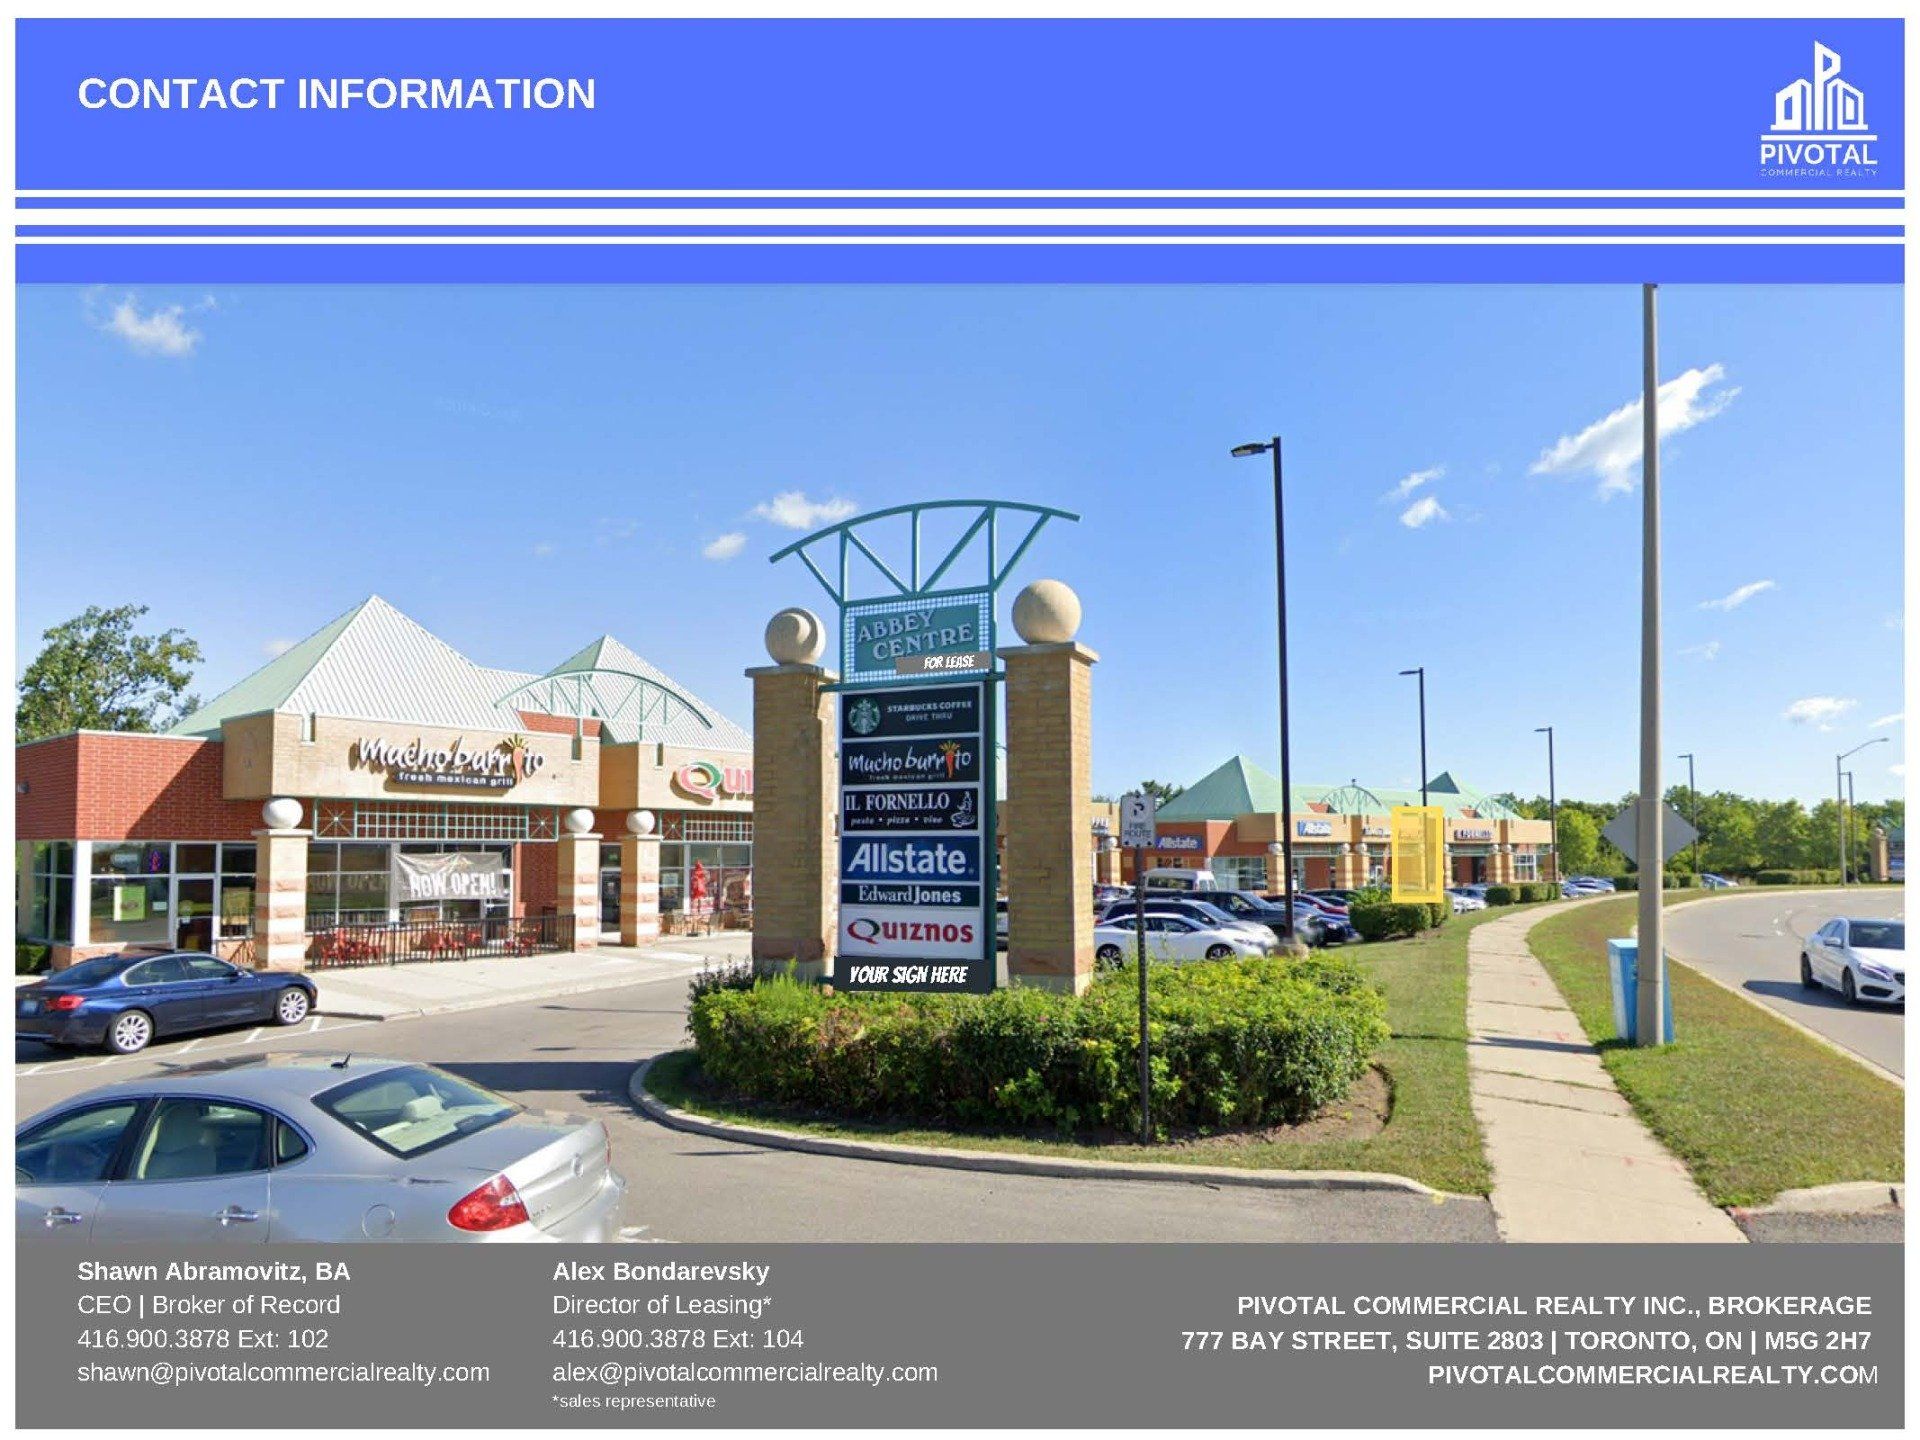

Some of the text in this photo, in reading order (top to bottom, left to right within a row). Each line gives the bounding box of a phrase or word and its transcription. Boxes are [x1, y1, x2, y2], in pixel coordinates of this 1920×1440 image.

[858, 610, 935, 642] ABBEY
[873, 623, 975, 660] CENTRE
[886, 699, 973, 712] STARBUCKS COFFEE
[906, 713, 929, 722] DRIVE
[357, 734, 546, 784] Mucho burrito
[848, 741, 972, 778] Mucho burrito
[398, 772, 514, 788] fresh mexican grill
[845, 791, 950, 811] IL FORNELLO
[847, 842, 967, 874] Allstate
[410, 871, 496, 899] NOW OPEN!
